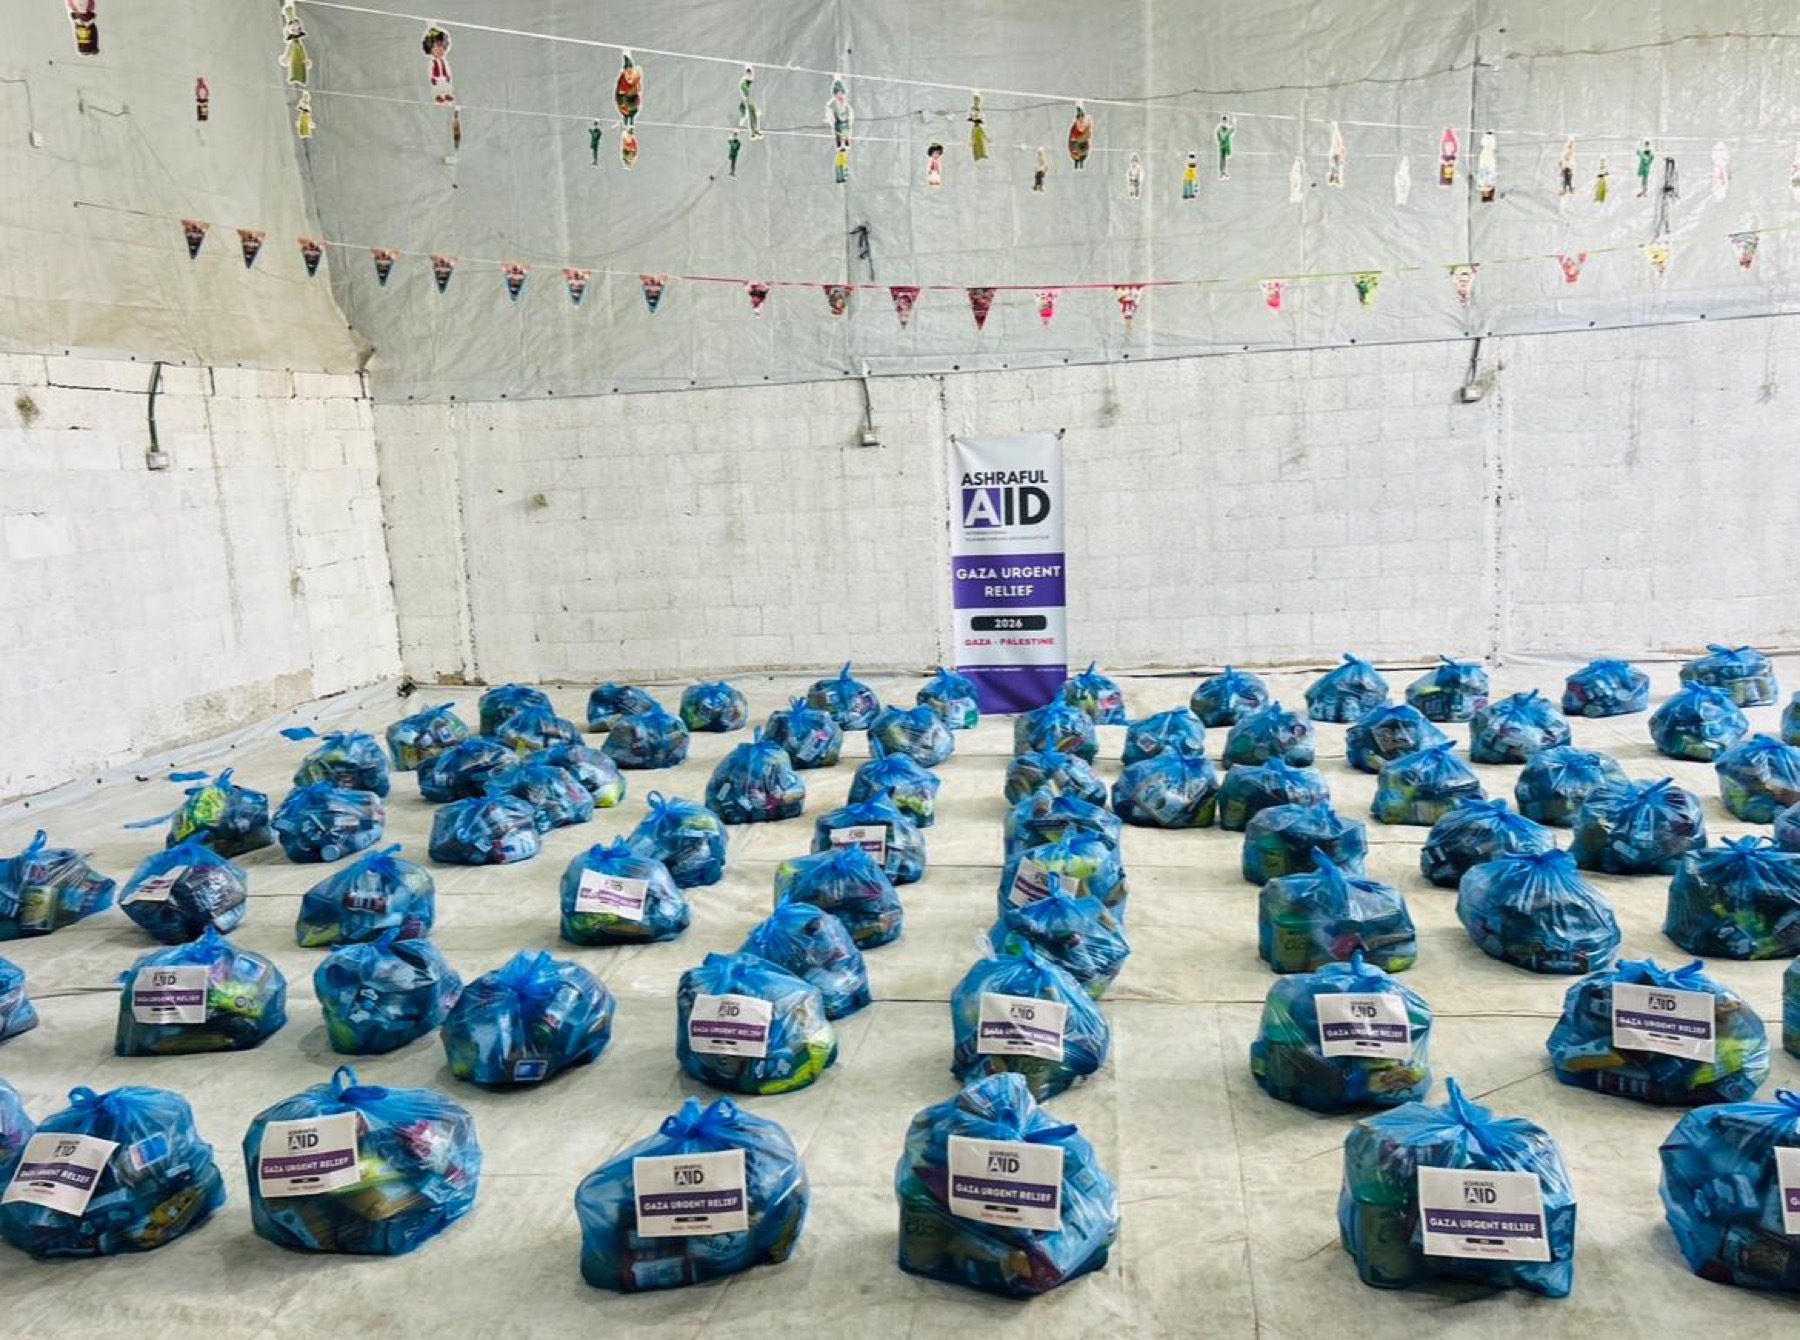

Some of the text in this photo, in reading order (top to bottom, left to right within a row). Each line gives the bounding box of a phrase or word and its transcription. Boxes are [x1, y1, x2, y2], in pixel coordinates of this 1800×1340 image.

[961, 470, 1049, 486] ASHRAFUL
[962, 486, 1051, 528] AID
[956, 565, 1061, 580] GAZA URGENT
[985, 585, 1034, 597] RELIEF
[994, 618, 1023, 629] 2026
[965, 638, 992, 646] GAZA
[1000, 637, 1055, 646] PALESTINE
[1619, 1017, 1642, 1026] GAZA
[1326, 1030, 1349, 1038] GAZA
[288, 1133, 319, 1150] AID
[264, 1156, 349, 1174] GAZA URGENT RELIEF
[988, 1156, 1020, 1173] AID
[60, 1169, 92, 1183] RELIEF
[674, 1170, 704, 1186] AID
[955, 1183, 1052, 1202] GAZA URGENT RELIEF
[1464, 1187, 1496, 1204] AID
[643, 1196, 738, 1211] GAZA URGENT RELIEF
[1429, 1217, 1536, 1232] GAZA URGENT RELIEF
